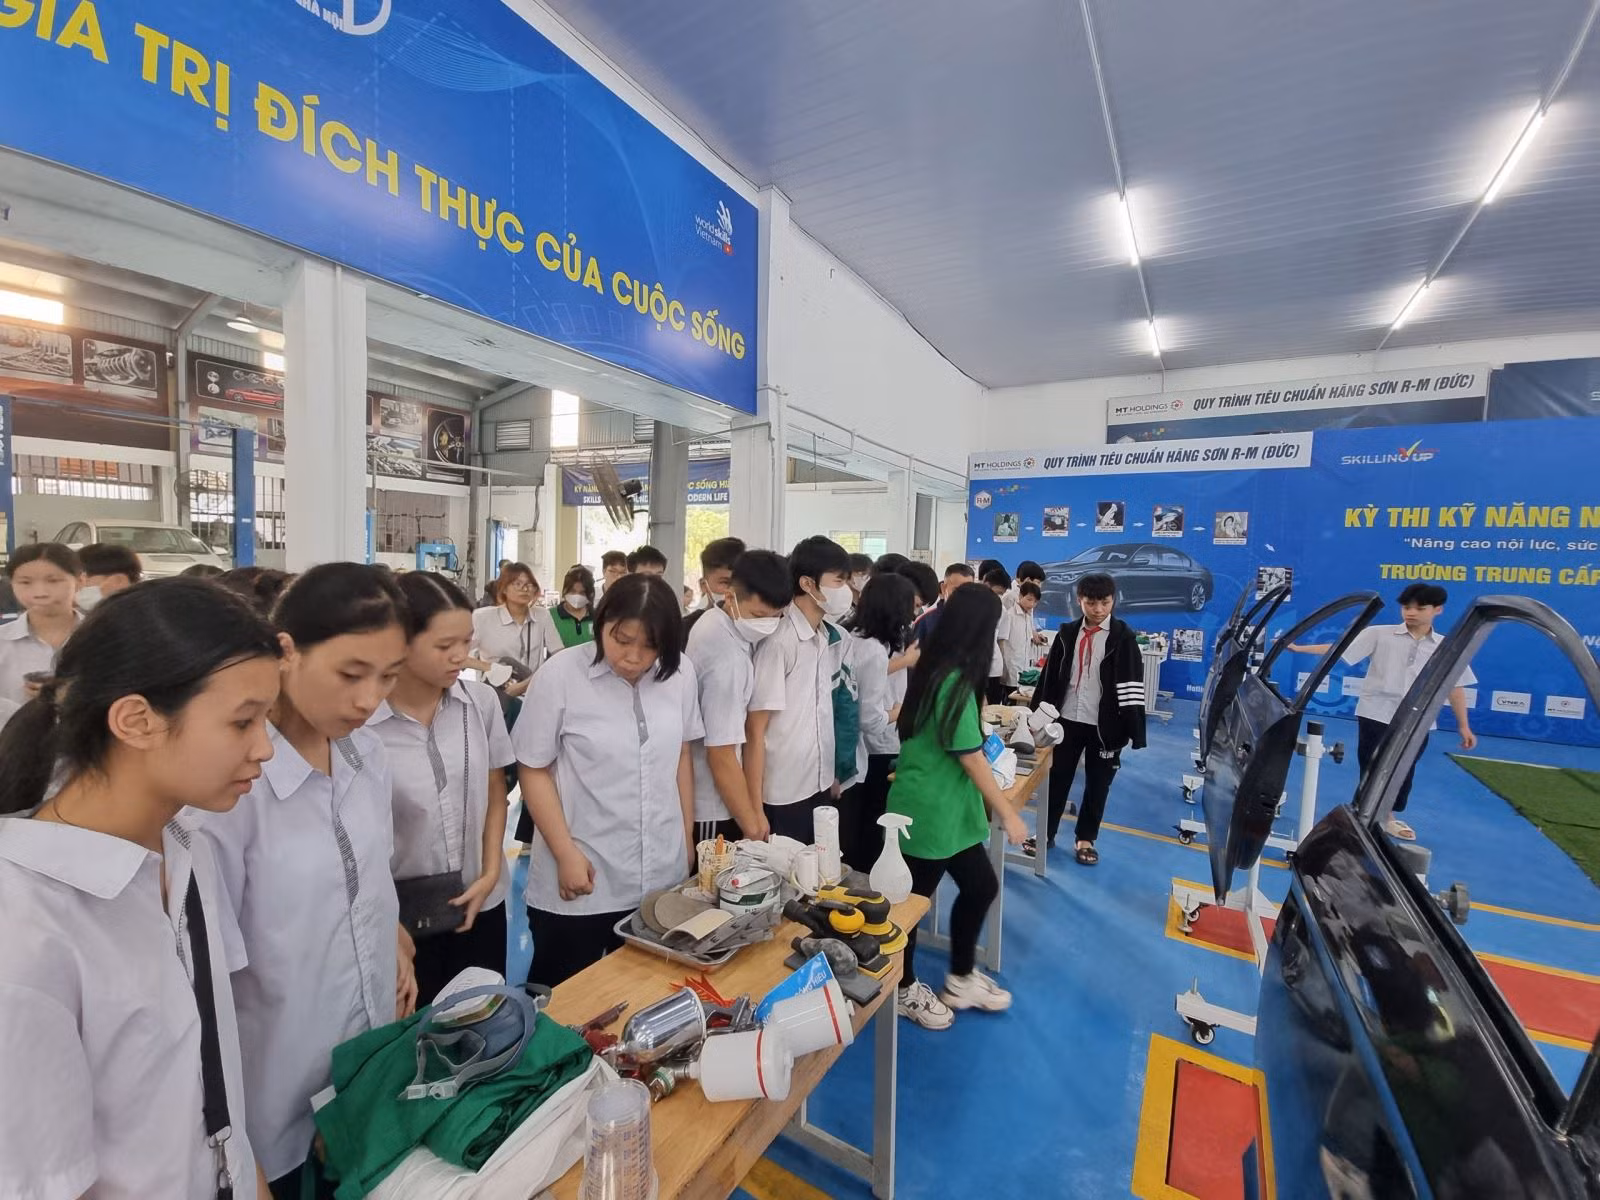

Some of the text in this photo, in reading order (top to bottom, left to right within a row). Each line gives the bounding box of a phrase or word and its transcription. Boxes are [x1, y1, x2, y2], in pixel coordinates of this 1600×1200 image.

[134, 22, 230, 132] TRỊ
[254, 81, 399, 197] ĐÍCH
[414, 163, 525, 253] THỰC
[536, 232, 604, 295] CỦA
[612, 271, 685, 331] CUỘC
[691, 309, 745, 360] SỐNG
[1193, 397, 1214, 411] QUY
[1218, 394, 1252, 408] TRÌNH
[1255, 390, 1280, 405] TIÊU
[1283, 383, 1326, 402] CHUẨN
[1368, 380, 1399, 395] SƠN
[1401, 378, 1431, 393] R-M
[1434, 373, 1475, 391] (ĐỨC)
[1129, 403, 1168, 412] HOLDINGS
[1044, 457, 1063, 469] QUY
[1066, 453, 1097, 468] TRÌNH
[1099, 452, 1122, 466] TIÊU
[1125, 447, 1162, 465] CHUẨN
[1202, 447, 1229, 461] SƠN
[1231, 446, 1259, 460] R-M
[1261, 442, 1300, 459] (ĐỨC)
[696, 479, 717, 489] SỐNG
[687, 493, 712, 502] ODERN
[1344, 504, 1379, 528] KỲ
[1387, 507, 1430, 528] THI
[1438, 502, 1477, 528] KỸ
[1485, 502, 1571, 528] NĂNG
[1461, 540, 1492, 549] cao
[1497, 538, 1524, 551] nội
[1567, 538, 1598, 551] sức
[1380, 562, 1467, 582] TRƯỜNG
[1474, 566, 1551, 584] TRUNG
